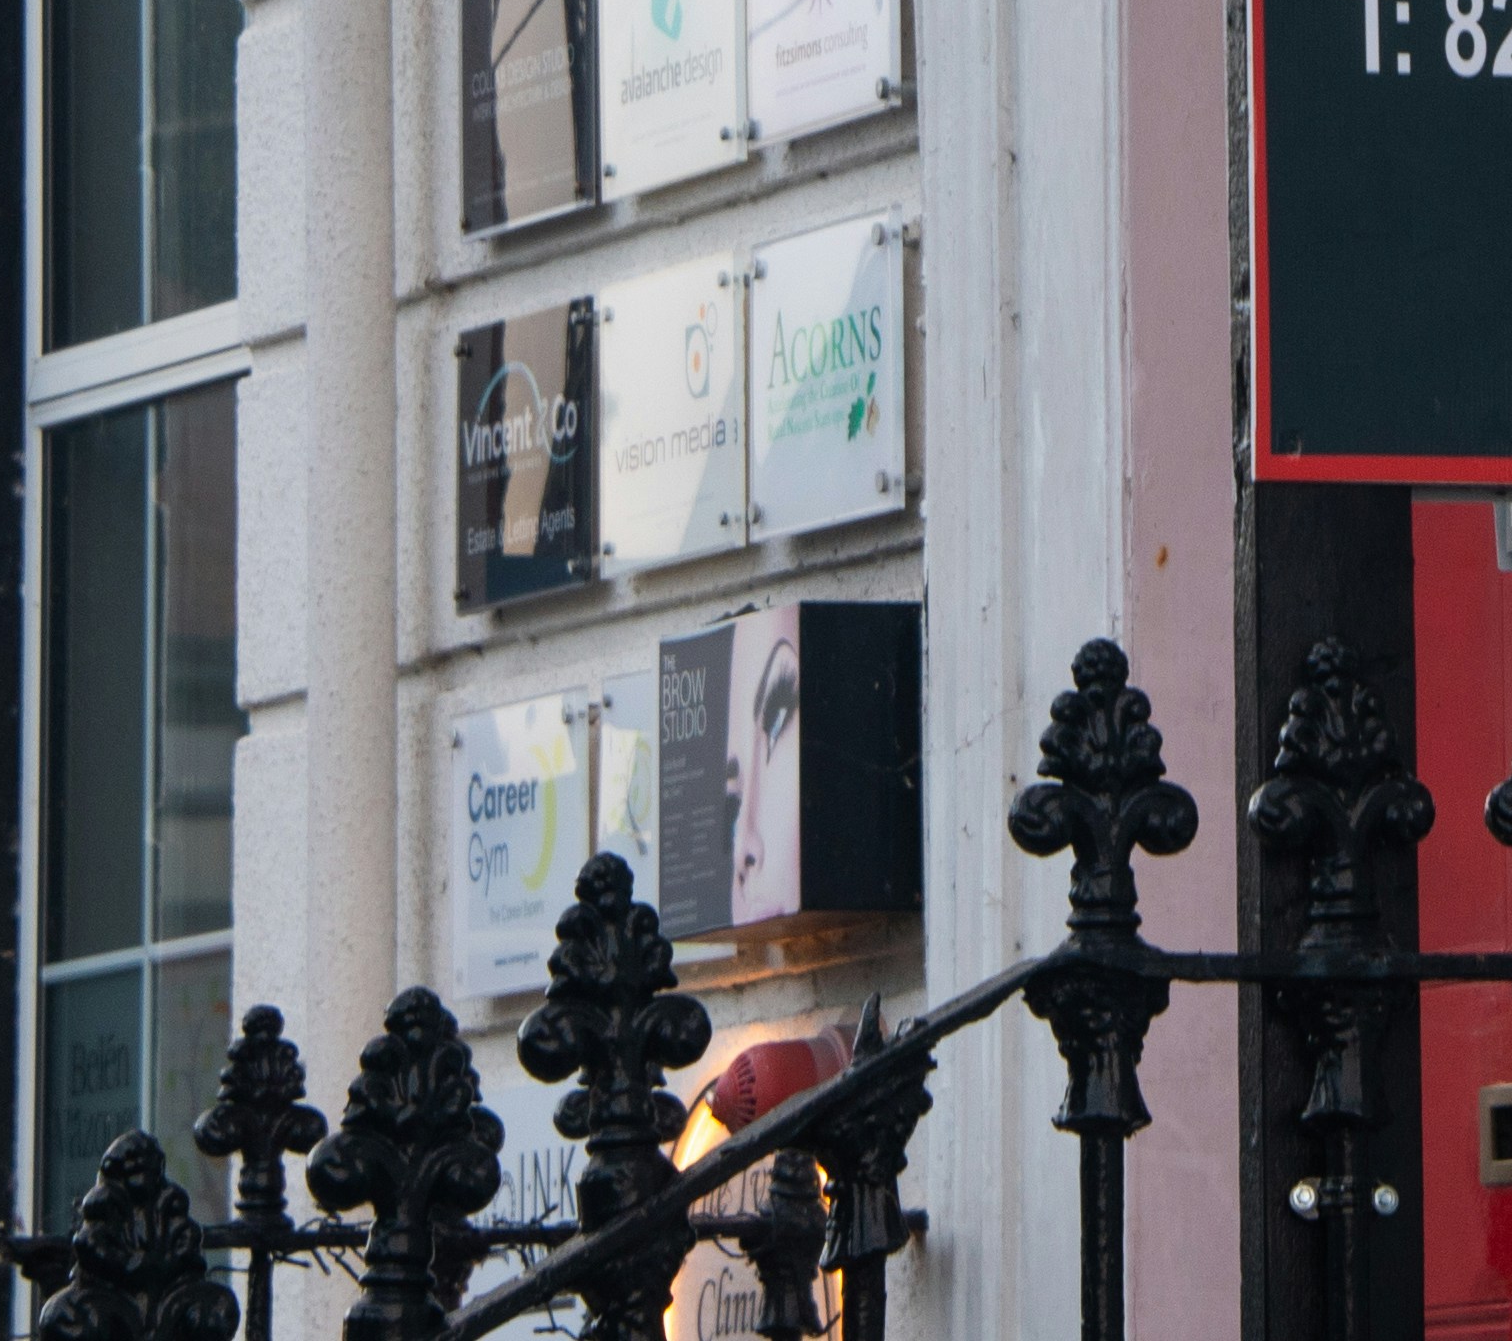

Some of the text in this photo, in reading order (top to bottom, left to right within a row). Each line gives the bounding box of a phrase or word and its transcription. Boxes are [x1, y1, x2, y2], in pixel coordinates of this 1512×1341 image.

[823, 20, 868, 53] consulting
[620, 54, 681, 105] avalanche
[683, 44, 723, 85] design
[463, 405, 533, 468] Vincent
[551, 393, 578, 444] Co
[615, 432, 666, 474] vision
[671, 412, 726, 458] media
[541, 505, 576, 541] Agents
[662, 667, 707, 710] BROW
[662, 704, 708, 745] STUDIO
[468, 770, 538, 824] Career
[468, 830, 510, 898] Gym
[697, 1264, 767, 1341] Clini
